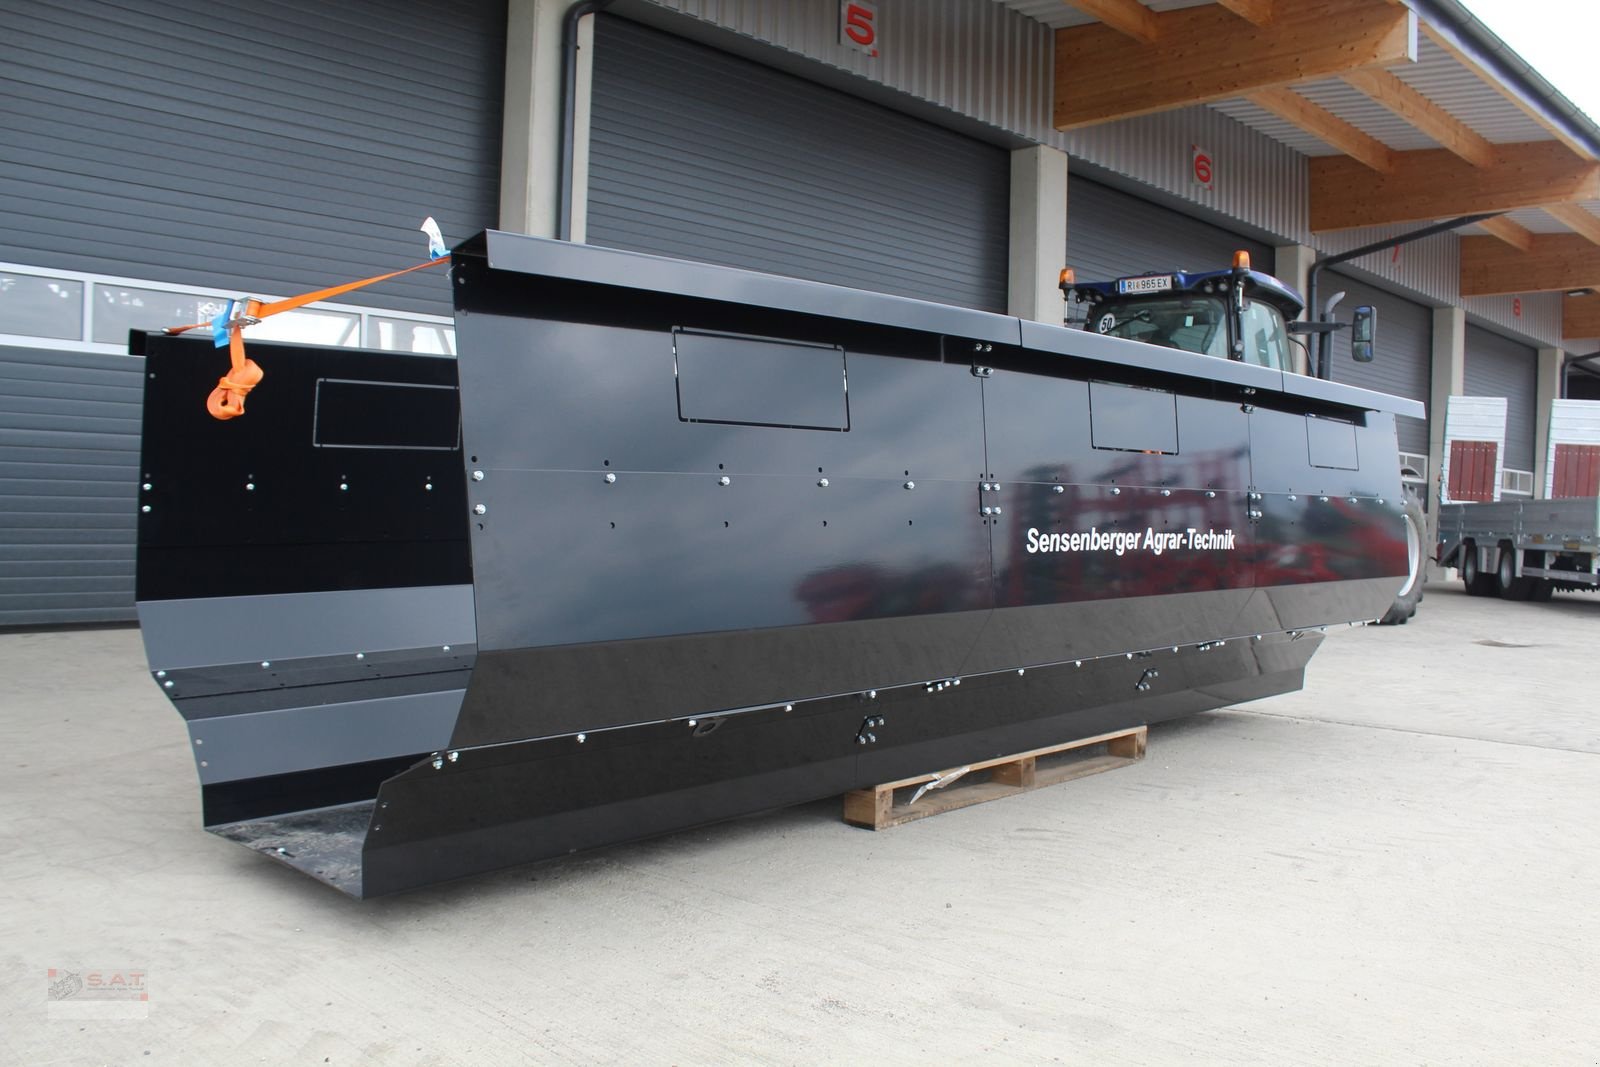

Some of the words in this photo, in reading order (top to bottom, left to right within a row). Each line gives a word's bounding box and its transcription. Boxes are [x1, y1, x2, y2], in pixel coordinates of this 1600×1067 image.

[845, 3, 875, 46] 5
[1194, 154, 1212, 183] 6
[1140, 279, 1157, 290] 965
[1157, 277, 1168, 289] EX
[1101, 317, 1113, 332] 50
[1026, 526, 1141, 556] Sensenberger
[1142, 527, 1235, 556] Agrar-Technik
